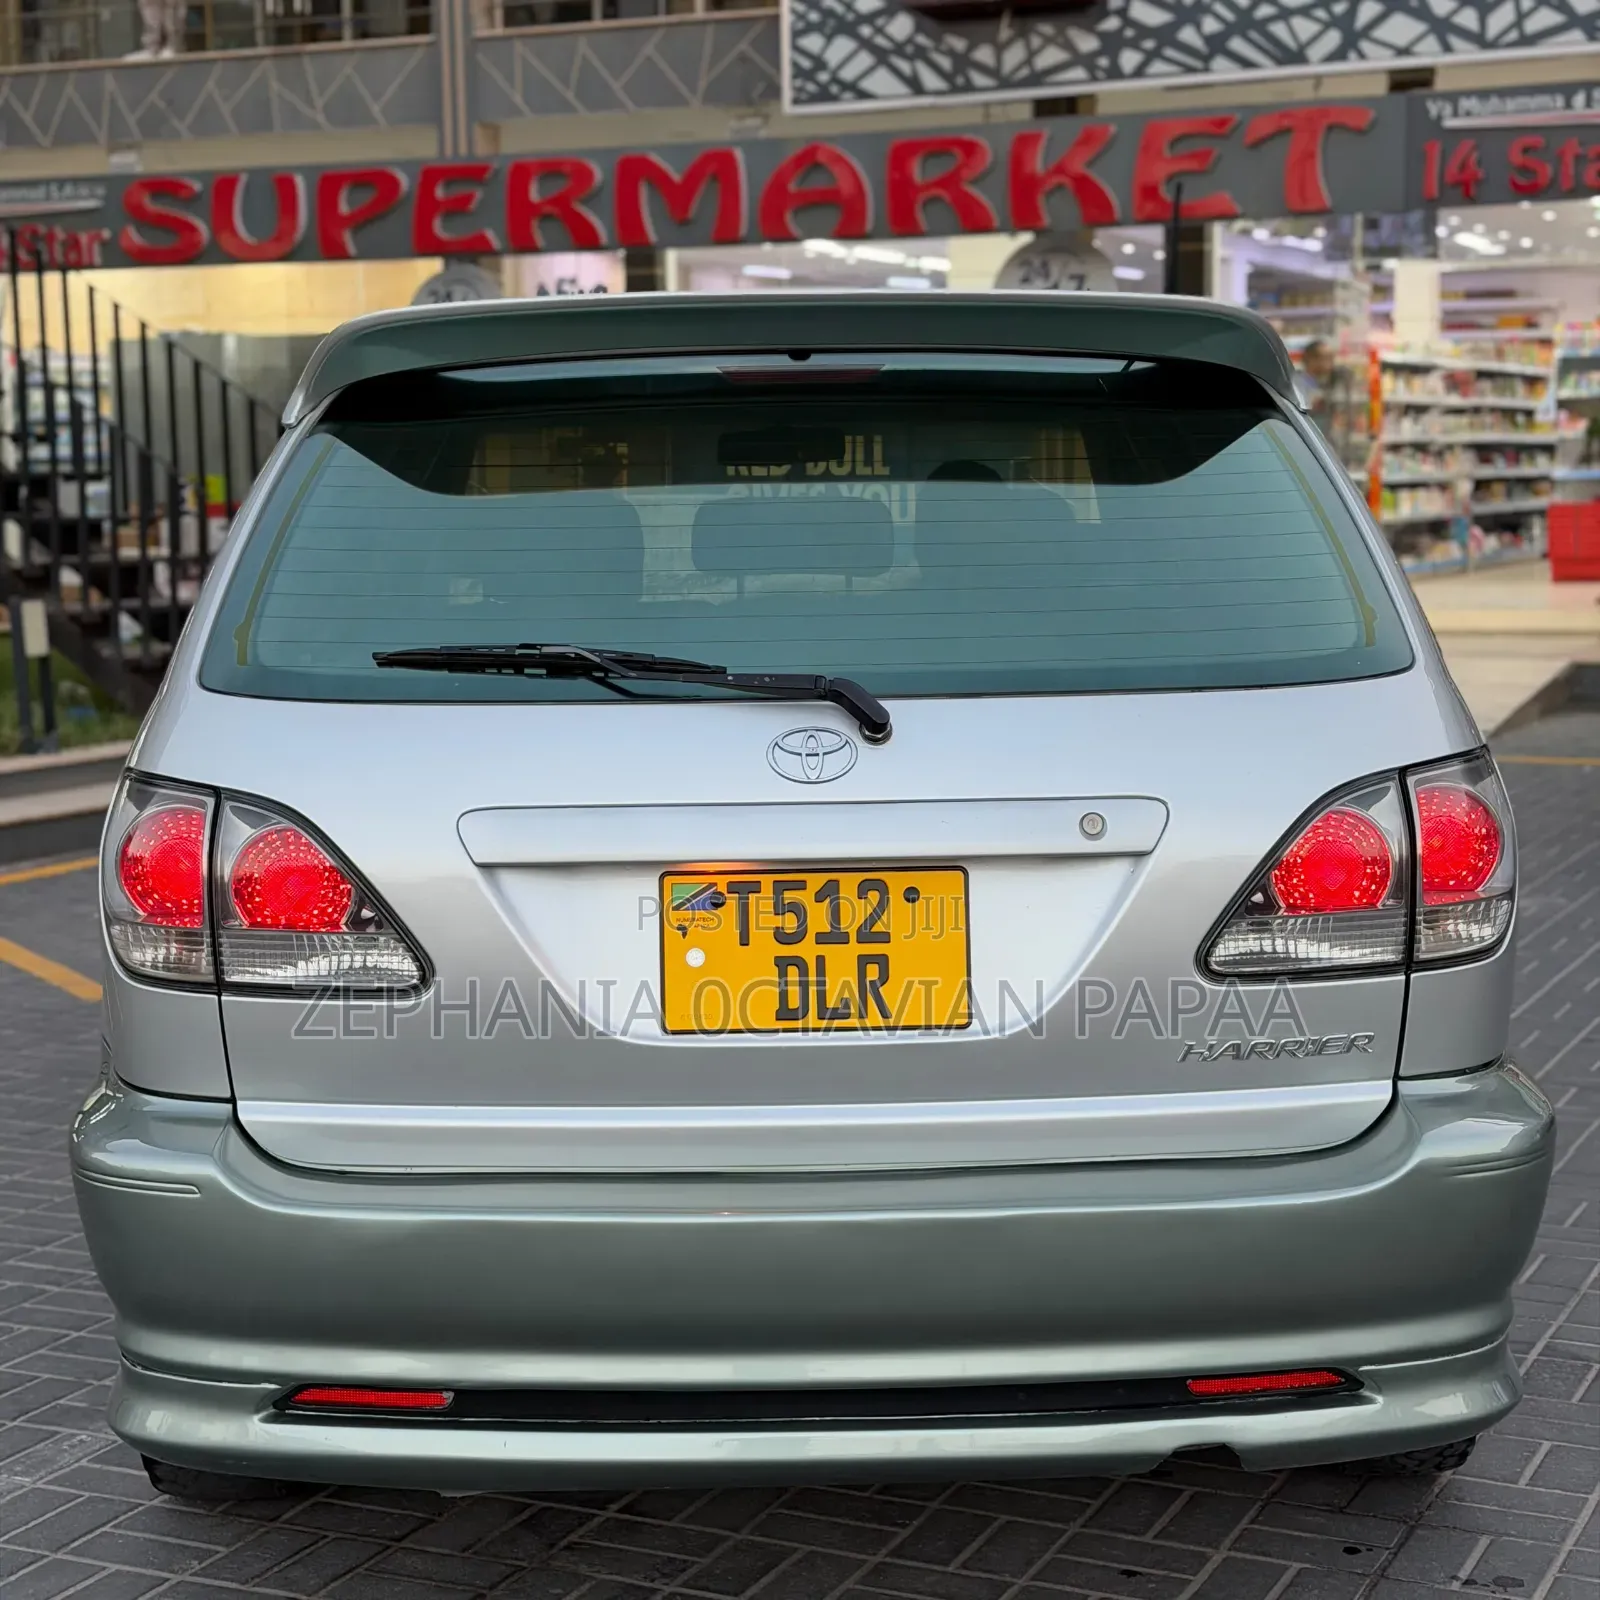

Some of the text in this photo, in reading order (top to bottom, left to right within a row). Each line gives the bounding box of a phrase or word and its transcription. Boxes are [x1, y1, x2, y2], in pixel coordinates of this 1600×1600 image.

[119, 106, 1374, 264] SUPERMARKET
[1422, 138, 1485, 200] 14
[774, 953, 893, 1021] DLR
[1176, 1031, 1375, 1064] HARRIER
